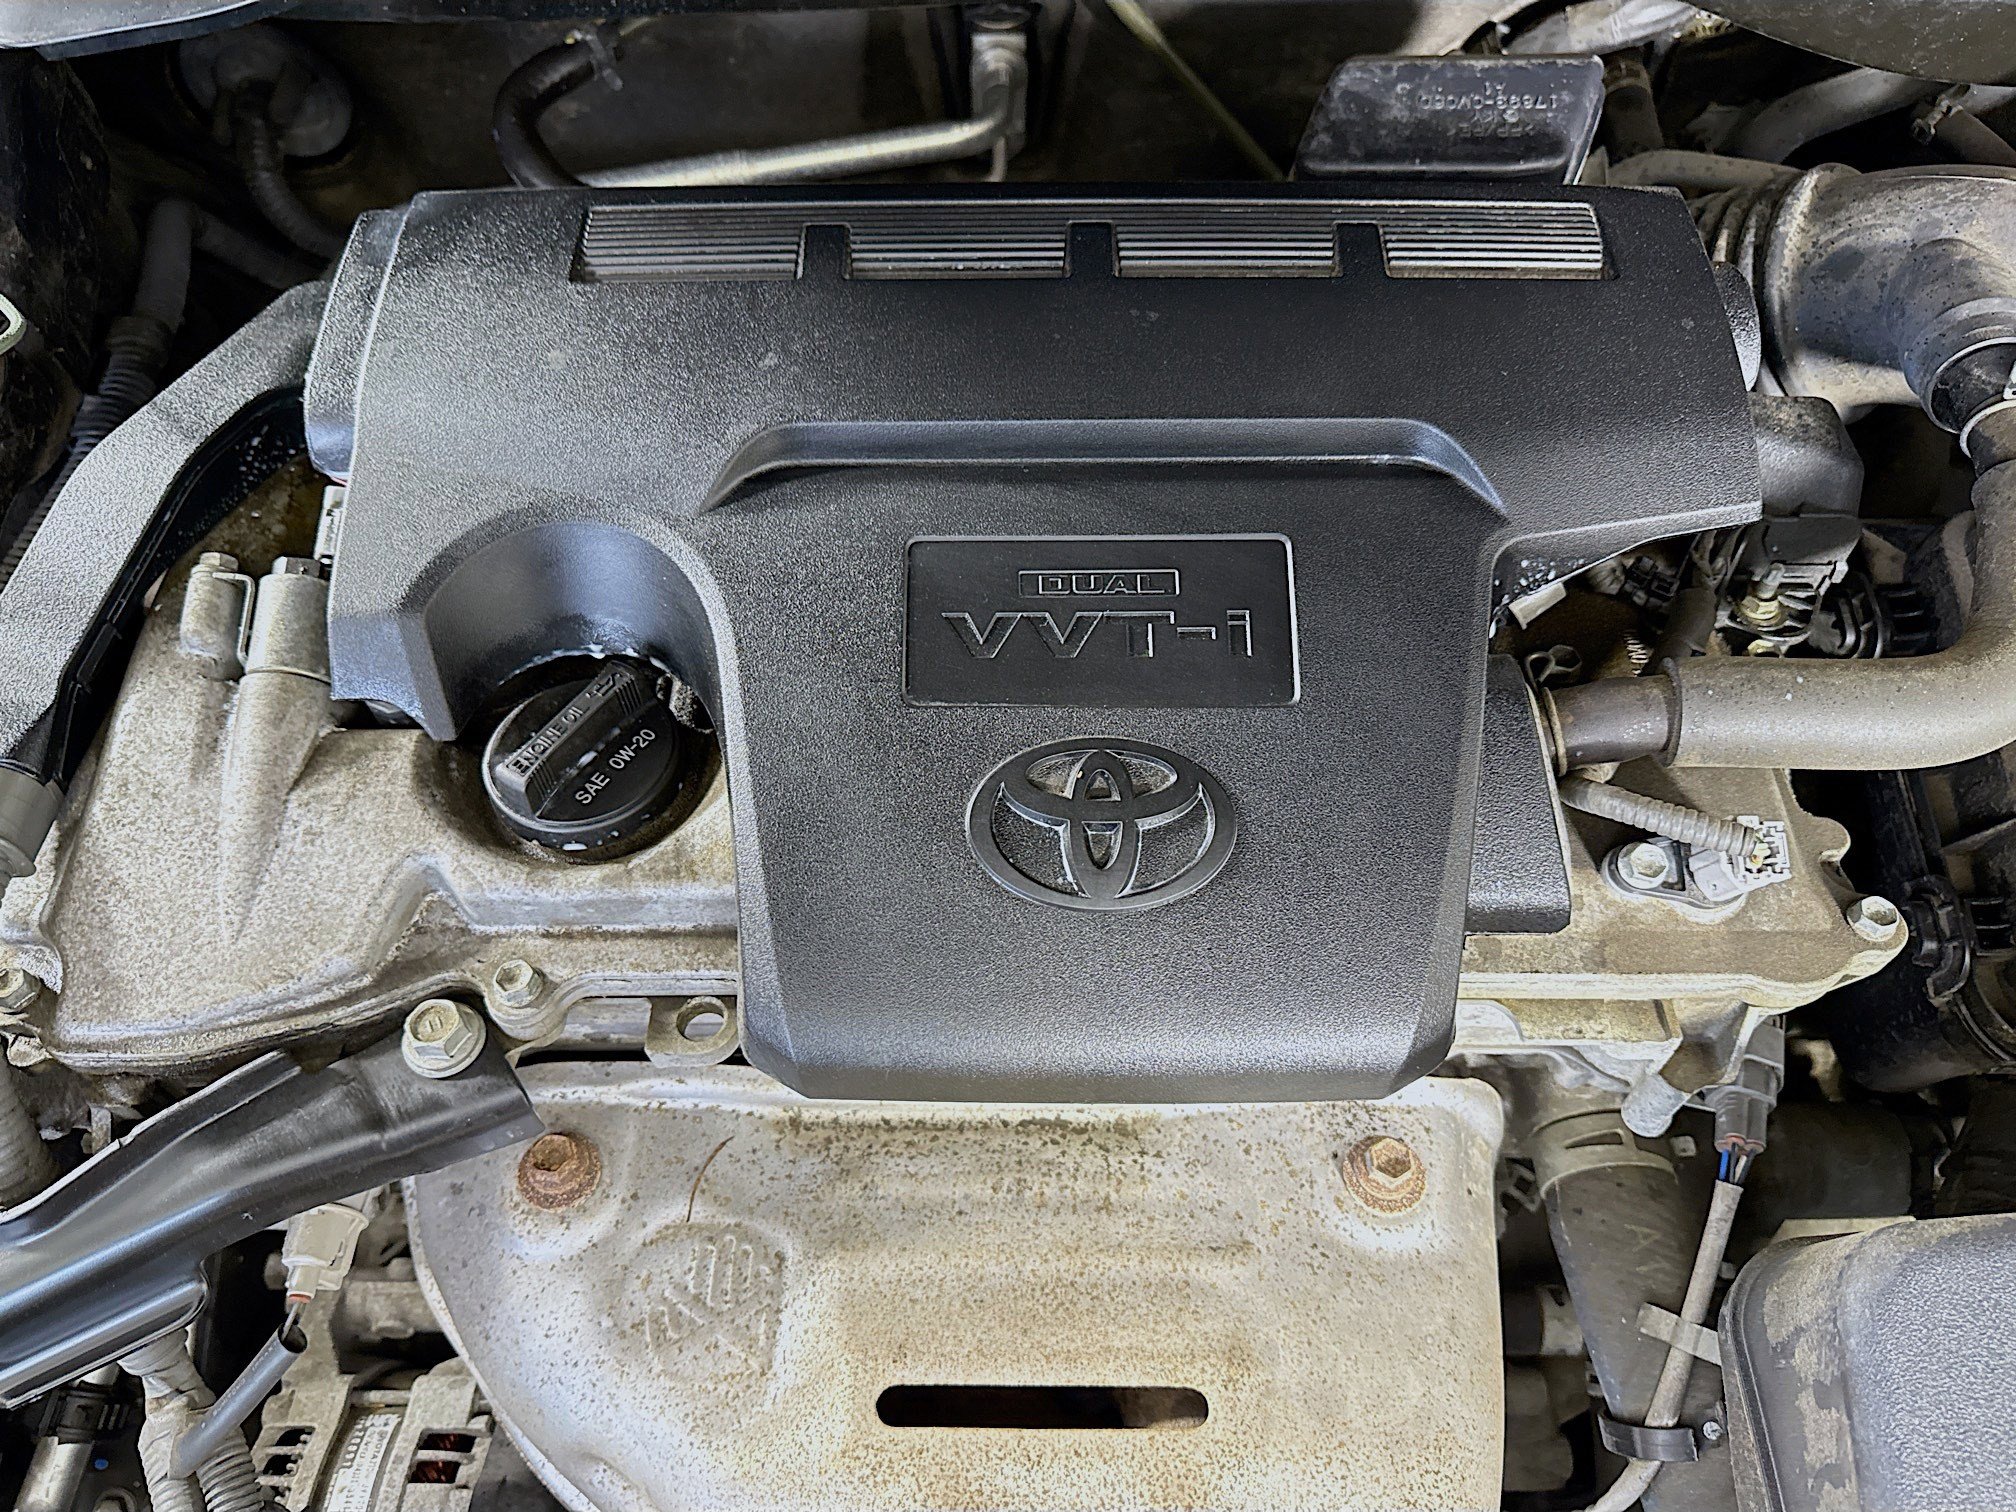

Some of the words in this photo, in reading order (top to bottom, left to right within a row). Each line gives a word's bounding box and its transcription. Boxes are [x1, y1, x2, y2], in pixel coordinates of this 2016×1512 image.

[1038, 574, 1165, 595] DUAL
[941, 609, 1253, 659] VVT-i
[507, 721, 566, 777] ENGINE
[562, 704, 591, 727] OIL
[575, 771, 611, 804] SAE
[609, 728, 657, 770] 0W-20
